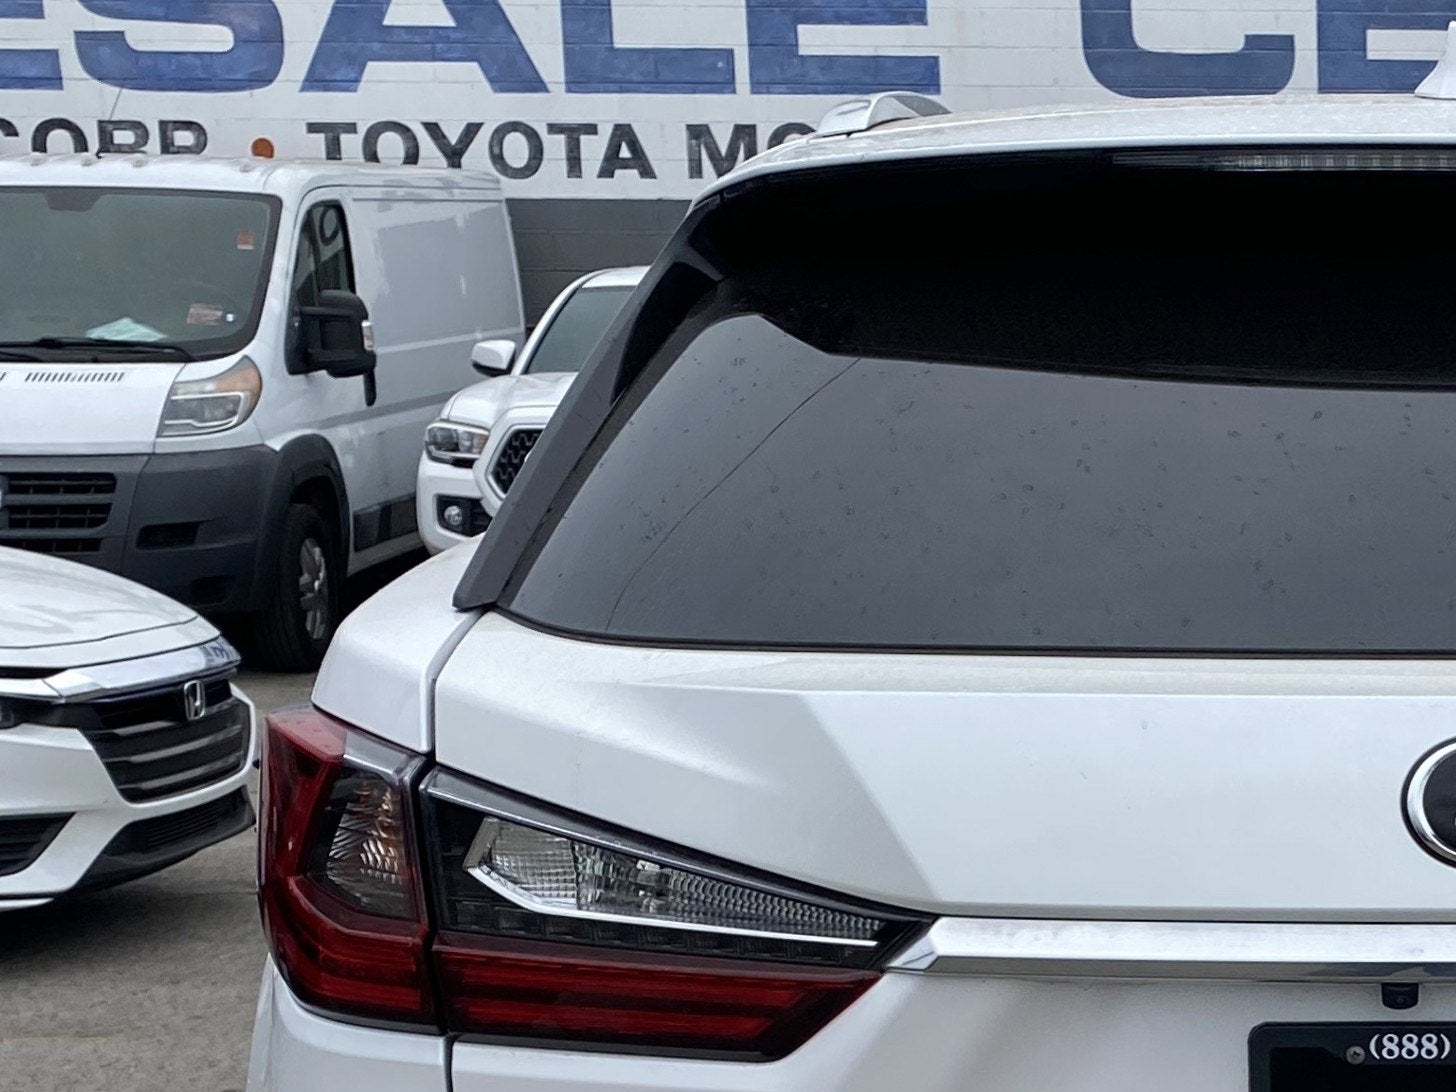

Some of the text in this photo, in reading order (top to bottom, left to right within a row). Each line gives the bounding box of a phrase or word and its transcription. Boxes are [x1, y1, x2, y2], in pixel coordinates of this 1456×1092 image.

[0, 0, 940, 95] SALE
[0, 117, 208, 155] ORP
[306, 120, 657, 180] TOYOTA
[1368, 1033, 1451, 1060] (888)
